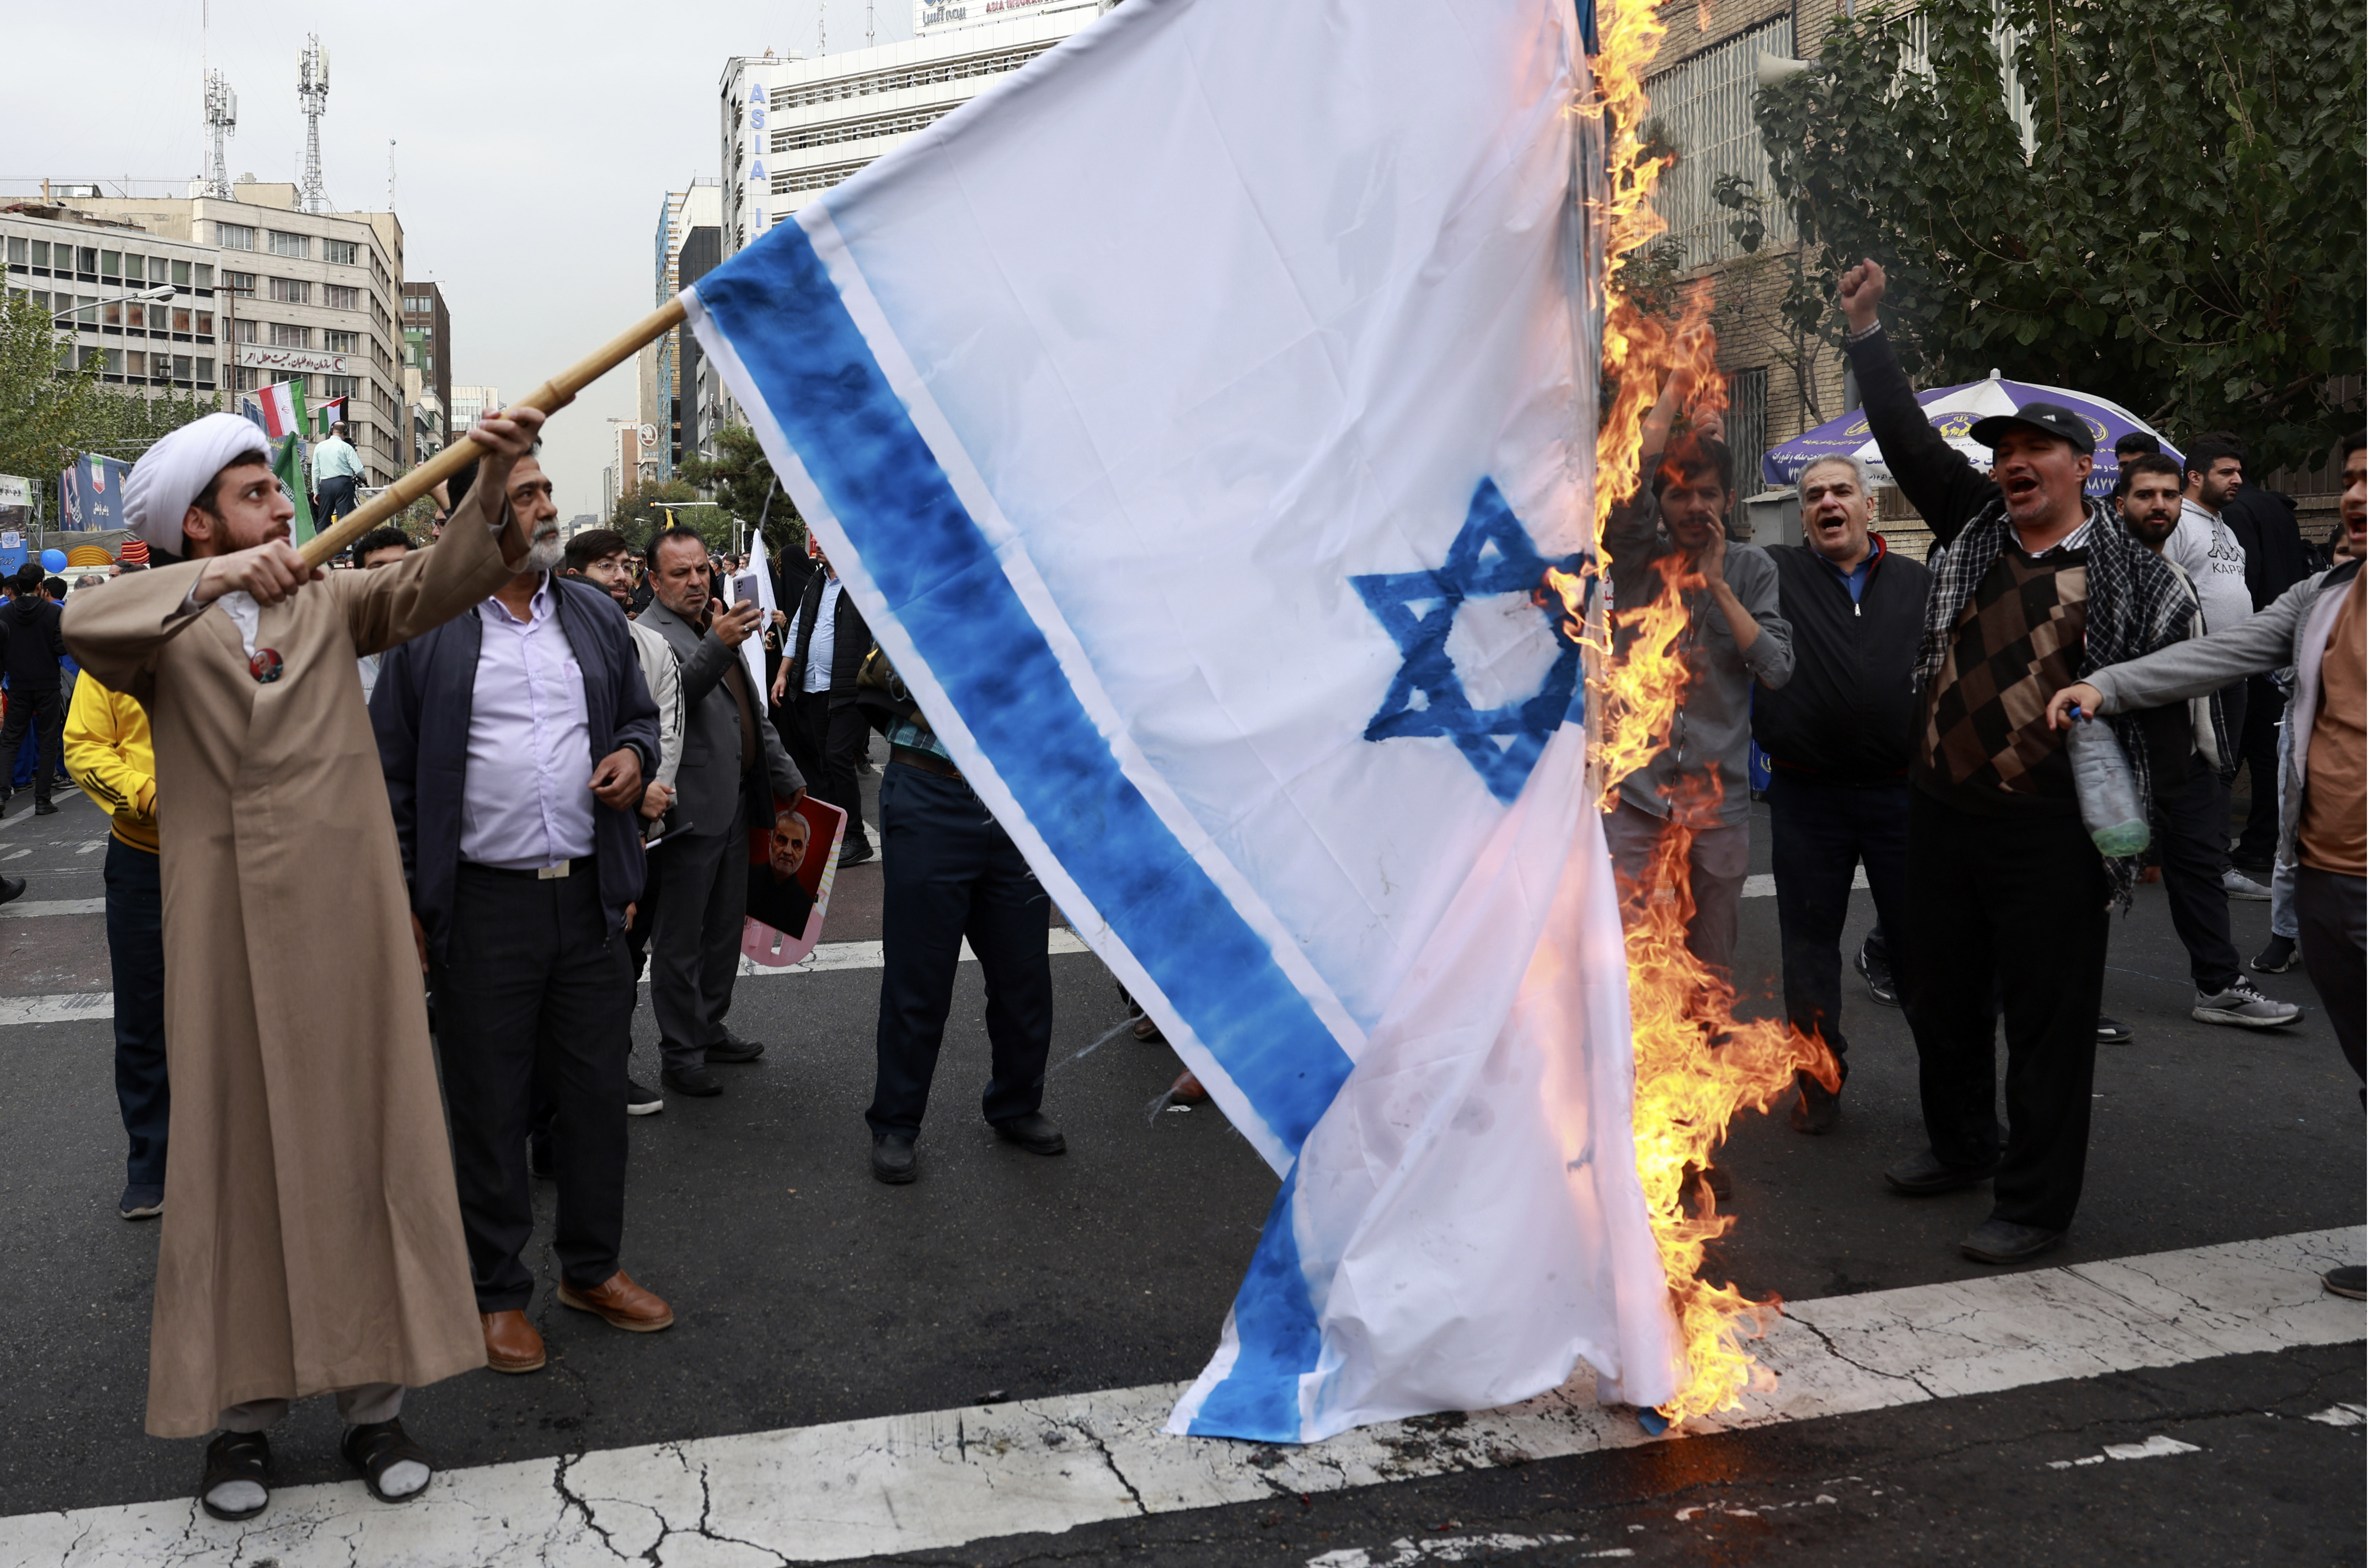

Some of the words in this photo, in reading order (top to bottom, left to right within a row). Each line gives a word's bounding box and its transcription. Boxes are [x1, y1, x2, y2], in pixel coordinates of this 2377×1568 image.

[986, 0, 1005, 13] ASIA
[749, 84, 766, 180] ASIA
[244, 353, 256, 363] احمر
[257, 350, 271, 364] هلال
[271, 353, 291, 366] جمعیت
[291, 354, 314, 368] داوطلبان
[314, 359, 331, 370] سازمان
